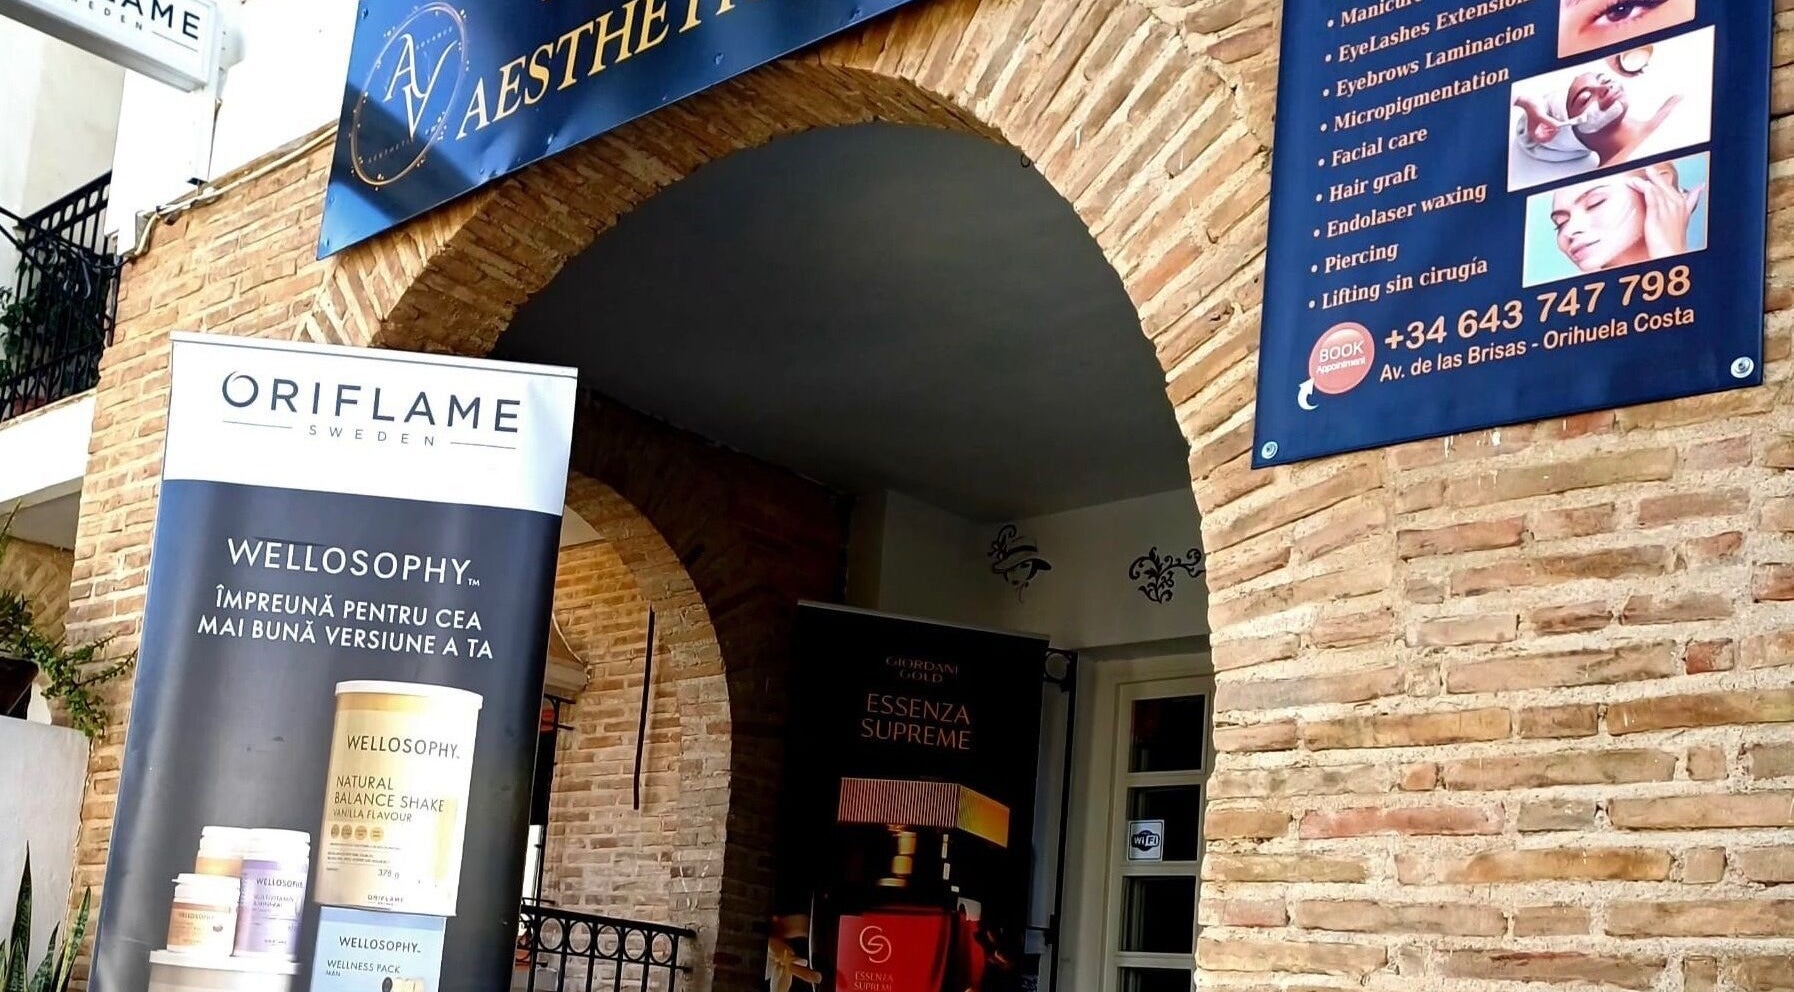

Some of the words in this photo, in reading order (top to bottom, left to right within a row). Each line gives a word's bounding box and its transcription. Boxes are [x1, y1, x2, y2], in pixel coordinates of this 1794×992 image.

[1335, 59, 1419, 97] Eyebrows
[1424, 22, 1535, 69] Laminacion
[1337, 21, 1430, 62] EyeLashes
[1333, 66, 1509, 132] Micropigmentation
[1331, 137, 1382, 167] Facial
[1388, 128, 1428, 150] care
[1328, 178, 1369, 202] Hair
[1372, 163, 1418, 193] graft
[1327, 203, 1417, 238] Endolaser
[1421, 184, 1488, 213] waxing
[1324, 243, 1399, 274] Piercing
[1322, 283, 1381, 310] Lifting
[1385, 274, 1413, 294] sin
[1419, 256, 1488, 287] cirugía
[1384, 315, 1447, 353] +34
[1457, 300, 1524, 339] 643
[1536, 281, 1605, 323] 747
[1618, 265, 1692, 306] 798
[1319, 341, 1364, 363] BOOK
[1379, 363, 1405, 383] Av.
[1410, 357, 1432, 376] de
[1436, 349, 1462, 371] las
[1467, 340, 1526, 364] Brisas
[1543, 321, 1628, 351] Orihuela
[1634, 306, 1695, 334] Costa
[1316, 357, 1366, 375] Appointment
[221, 369, 521, 433] ORIFLAME
[309, 425, 435, 447] SWEDEN
[215, 583, 335, 618] ÎMPREUNĂ
[343, 600, 428, 626] PENTRU
[435, 609, 482, 631] CEA
[197, 615, 244, 637] MAI
[251, 619, 316, 644] BUNĂ
[325, 626, 436, 655] VERSIUNE
[442, 637, 459, 656] A
[467, 638, 493, 659] TA
[886, 656, 959, 676] GIORDANI
[900, 669, 944, 683] GOLD
[867, 693, 970, 726] ESSENZA
[861, 718, 972, 750] SUPREME
[336, 775, 394, 791] NATURAL
[333, 808, 364, 819] VANILLA
[366, 810, 412, 822] FLAVOUR
[334, 792, 395, 808] BALANCE
[400, 795, 445, 813] SHAKE
[327, 960, 374, 972] WELLNESS
[376, 963, 401, 974] PACK
